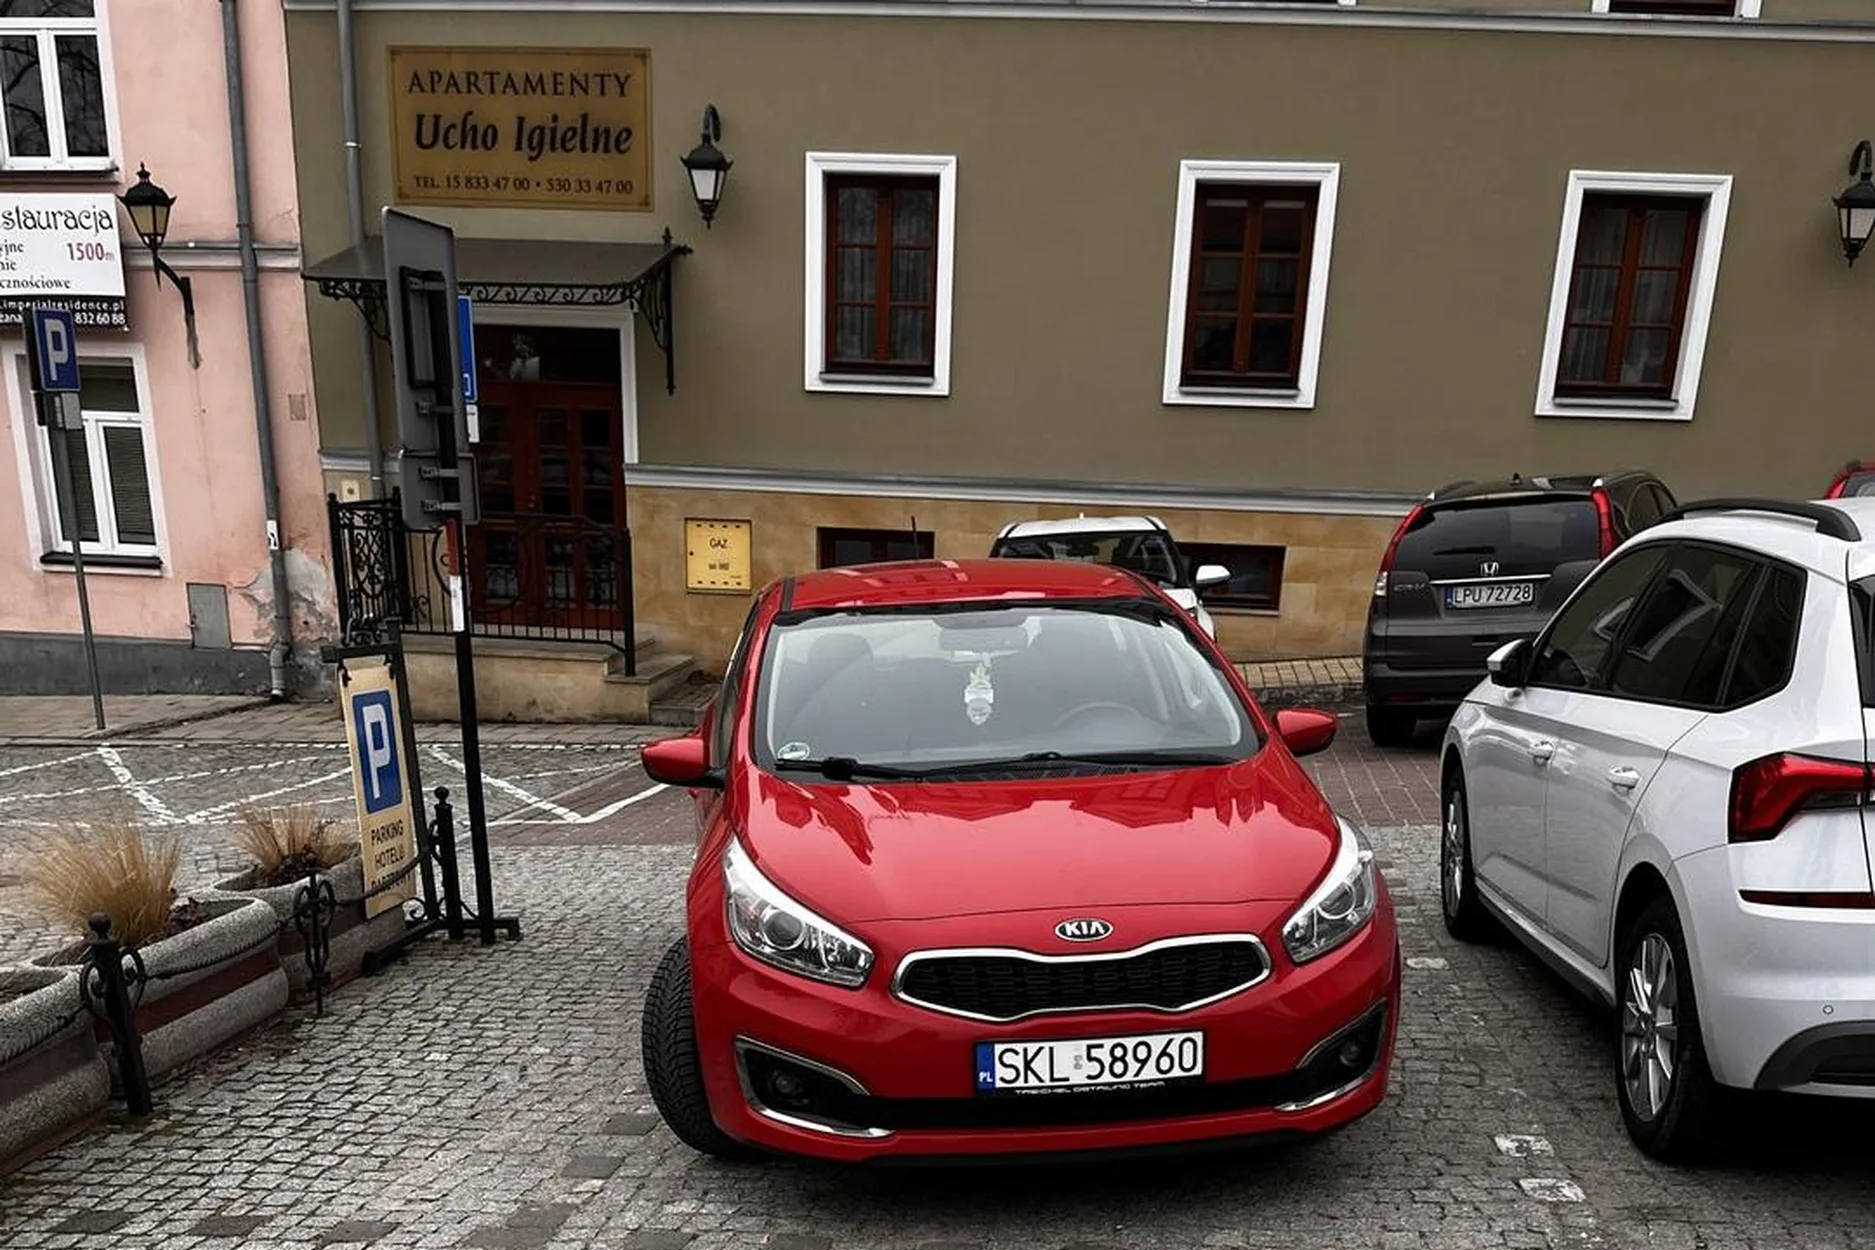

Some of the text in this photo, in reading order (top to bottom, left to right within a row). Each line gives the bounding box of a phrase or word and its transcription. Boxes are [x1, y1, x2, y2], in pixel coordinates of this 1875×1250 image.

[408, 70, 631, 97] APARTAMENTY
[416, 111, 633, 162] Ucho Igielne
[414, 175, 633, 194] TEL. 15 833 47 00 530 33 47 00
[44, 318, 69, 381] P
[1454, 584, 1531, 603] LPU 72728
[362, 703, 391, 800] P
[371, 819, 404, 846] PARKING
[1065, 921, 1105, 936] KIA
[998, 1037, 1199, 1085] SKL 58960
[979, 1072, 993, 1083] PL
